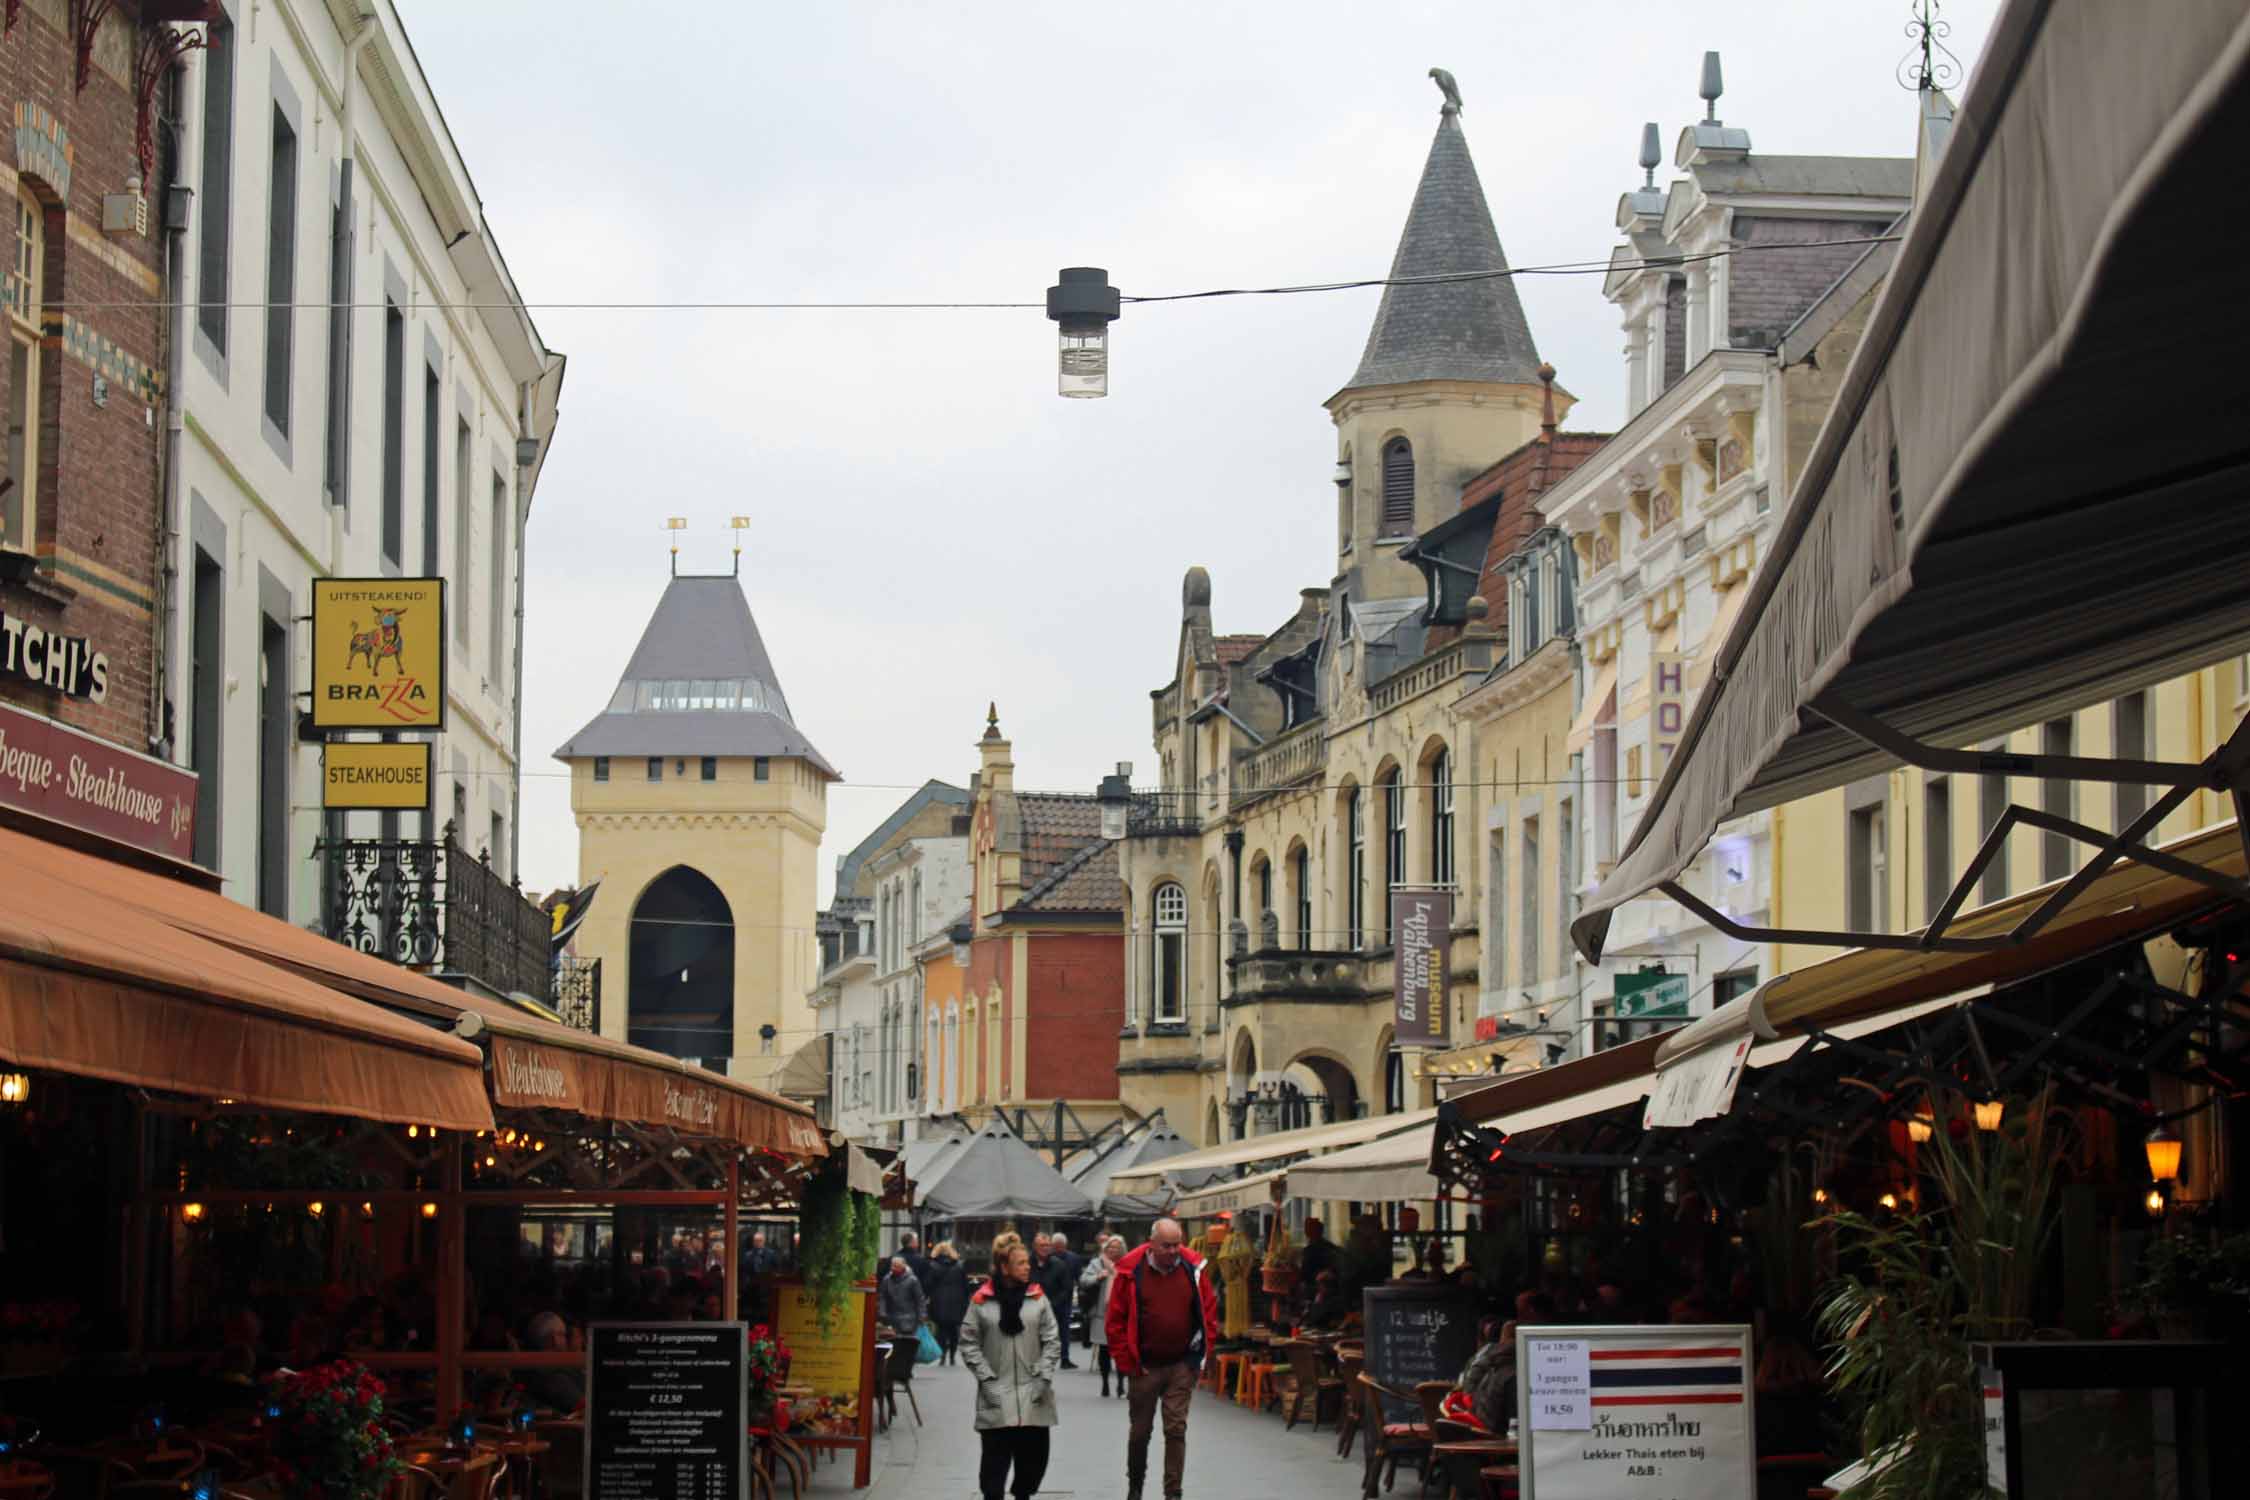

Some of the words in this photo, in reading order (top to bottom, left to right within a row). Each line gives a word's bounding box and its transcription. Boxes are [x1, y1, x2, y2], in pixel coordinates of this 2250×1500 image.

[329, 591, 427, 601] UITSTEAKEND!
[328, 678, 434, 722] BRAZZA
[65, 754, 163, 825] Steakhouse
[329, 767, 423, 784] STEAKHOUSE
[1415, 901, 1433, 949] Land
[1398, 918, 1419, 1022] Valkenburg
[1415, 954, 1429, 988] van
[1428, 949, 1442, 1035] museum
[1583, 1448, 1623, 1460] Lekker
[1625, 1447, 1657, 1459] Thais
[1660, 1447, 1687, 1459] eten
[1690, 1446, 1705, 1461] bij
[1627, 1465, 1656, 1477] A&B
